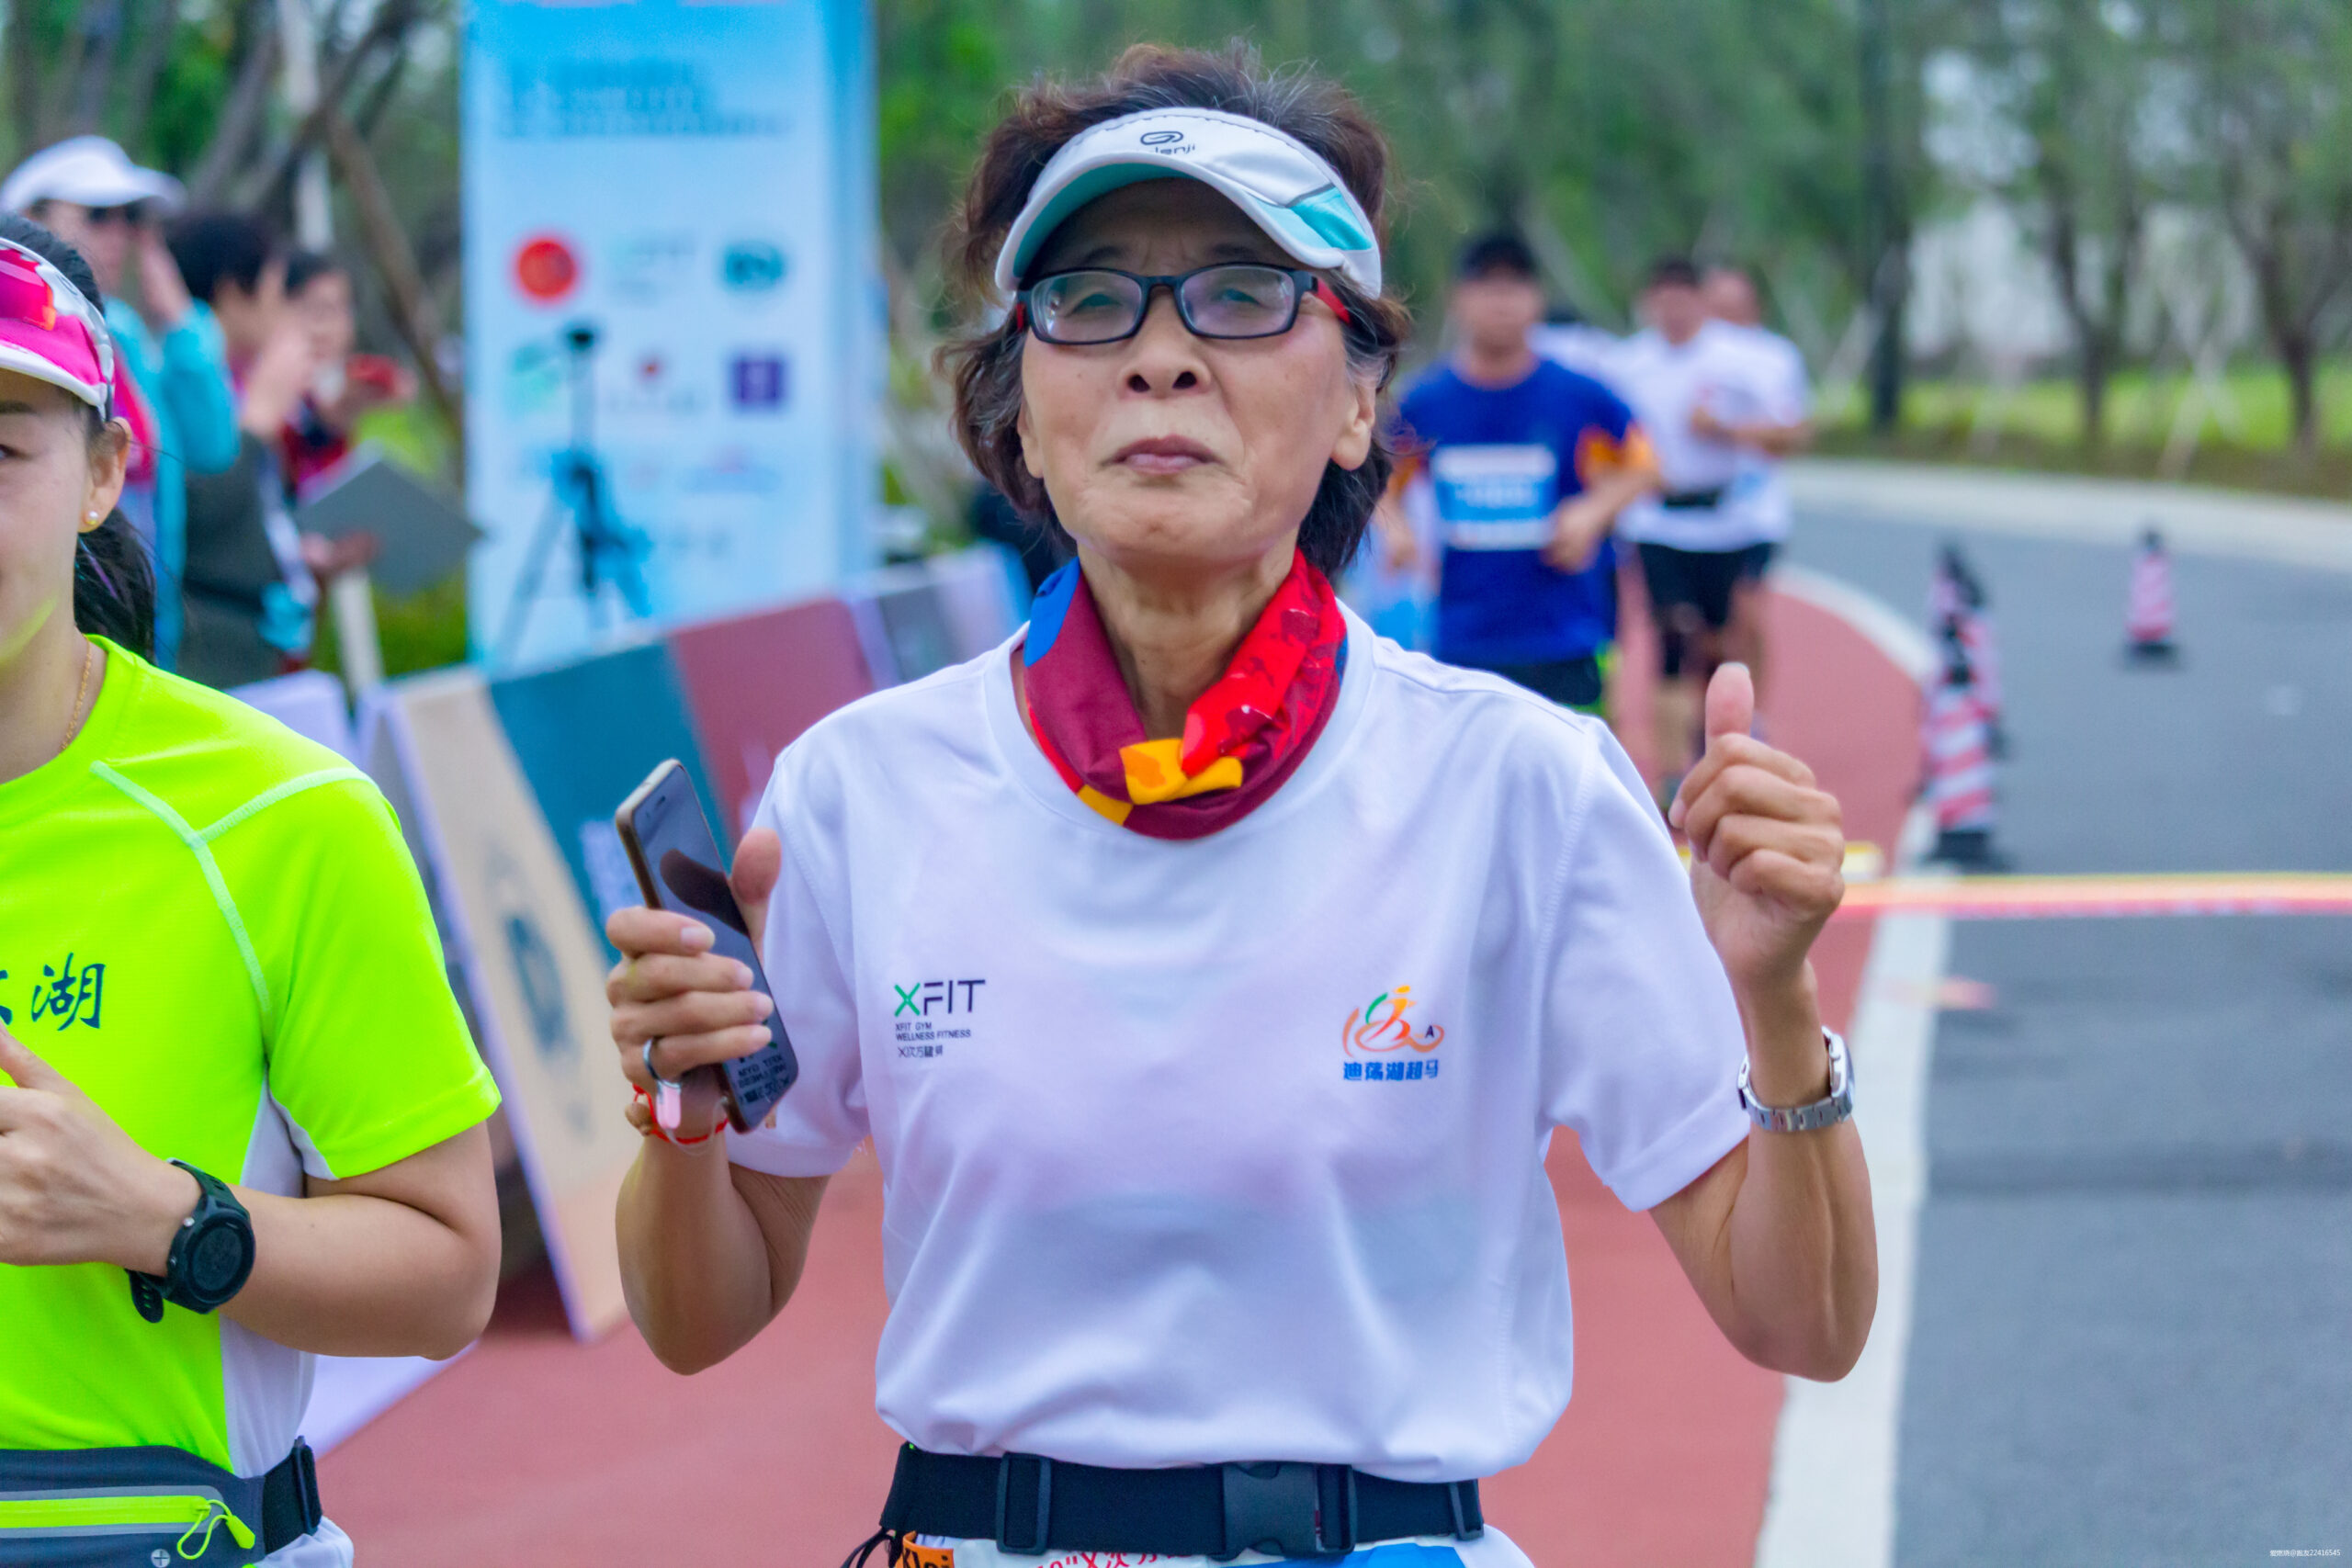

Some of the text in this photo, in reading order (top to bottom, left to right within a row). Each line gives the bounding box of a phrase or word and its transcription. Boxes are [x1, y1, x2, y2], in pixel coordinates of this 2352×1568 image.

[894, 979, 986, 1017] XFIT
[895, 1021, 932, 1031] XFIT GYM
[896, 1030, 971, 1041] WELLNESS FITNESS
